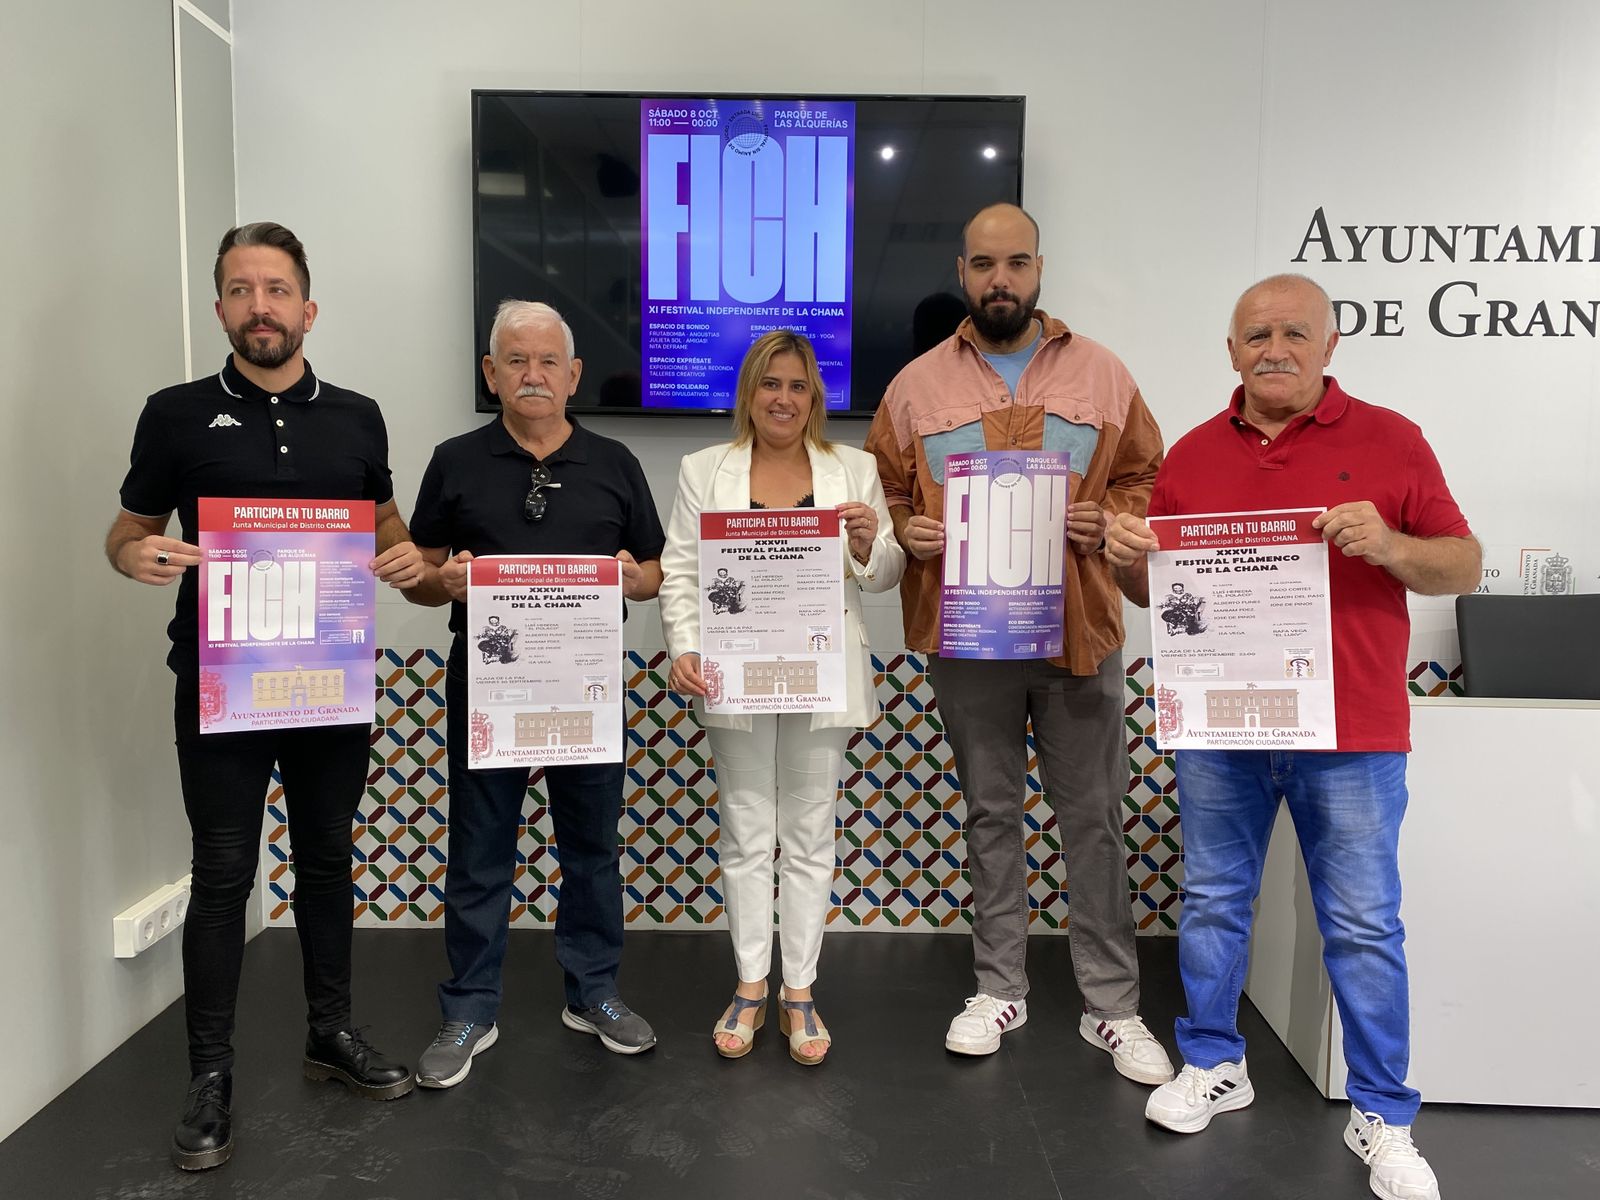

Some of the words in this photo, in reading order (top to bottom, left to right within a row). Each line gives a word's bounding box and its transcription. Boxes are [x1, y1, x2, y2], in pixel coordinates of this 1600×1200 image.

[648, 107, 688, 118] SÁBADO
[690, 109, 696, 118] 8
[698, 109, 719, 119] OCT
[774, 110, 813, 119] PARQUE
[815, 110, 828, 119] DE
[649, 118, 671, 127] 11:00
[691, 119, 718, 127] 00:00
[774, 119, 792, 128] LAS
[794, 118, 848, 128] ALQUERÍAS
[647, 133, 848, 304] FICH
[649, 305, 659, 314] XI
[660, 306, 704, 315] FESTIVAL
[706, 306, 780, 316] INDEPENDIENTE
[782, 307, 794, 316] DE
[796, 307, 808, 316] LA
[810, 308, 844, 317] CHANA
[676, 356, 712, 364] EXPRÉSATE
[948, 459, 969, 467] SÁBADO
[234, 506, 284, 519] PARTICIPA
[286, 507, 299, 519] EN
[301, 508, 313, 520] TU
[315, 508, 350, 520] BARRIO
[232, 521, 252, 529] Junta
[253, 521, 288, 530] Municipal
[726, 517, 766, 529] PARTICIPA
[767, 517, 778, 528] EN
[780, 517, 790, 527] TU
[792, 516, 819, 527] BARRIO
[944, 474, 1067, 588] FICH
[1180, 524, 1228, 537] PARTICIPA
[1231, 523, 1244, 535] EN
[1246, 522, 1258, 534] TU
[1260, 520, 1296, 533] BARRIO
[1199, 537, 1234, 546] Municipal
[1216, 548, 1258, 556] XXXVII
[1175, 558, 1230, 567] FESTIVAL
[1232, 555, 1300, 564] FLAMENCO
[499, 564, 541, 575] PARTICIPA
[543, 564, 554, 575] EN
[555, 564, 567, 575] TU
[568, 564, 597, 575] BARRIO
[1234, 564, 1279, 573] CHANA
[207, 560, 317, 641] FICH
[726, 696, 783, 704] AYUNTAMIENTO
[795, 694, 832, 703] GRANADA
[743, 703, 782, 711] PARTICIPACIÓN
[230, 709, 300, 721] AYUNTAMIENTO
[317, 705, 360, 716] GRANADA
[251, 716, 299, 726] PARTICIPACIÓN
[300, 715, 339, 724] CIUDADANA
[1186, 728, 1255, 738] AYUNTAMIENTO
[1272, 728, 1316, 738] GRANADA
[1206, 737, 1254, 746] PARTICIPACIÓN
[1255, 738, 1295, 746] CIUDADANA
[495, 748, 554, 758] AYUNTAMIENTO
[570, 745, 607, 754] GRANADA
[513, 755, 554, 763] PARTICIPACIÓN
